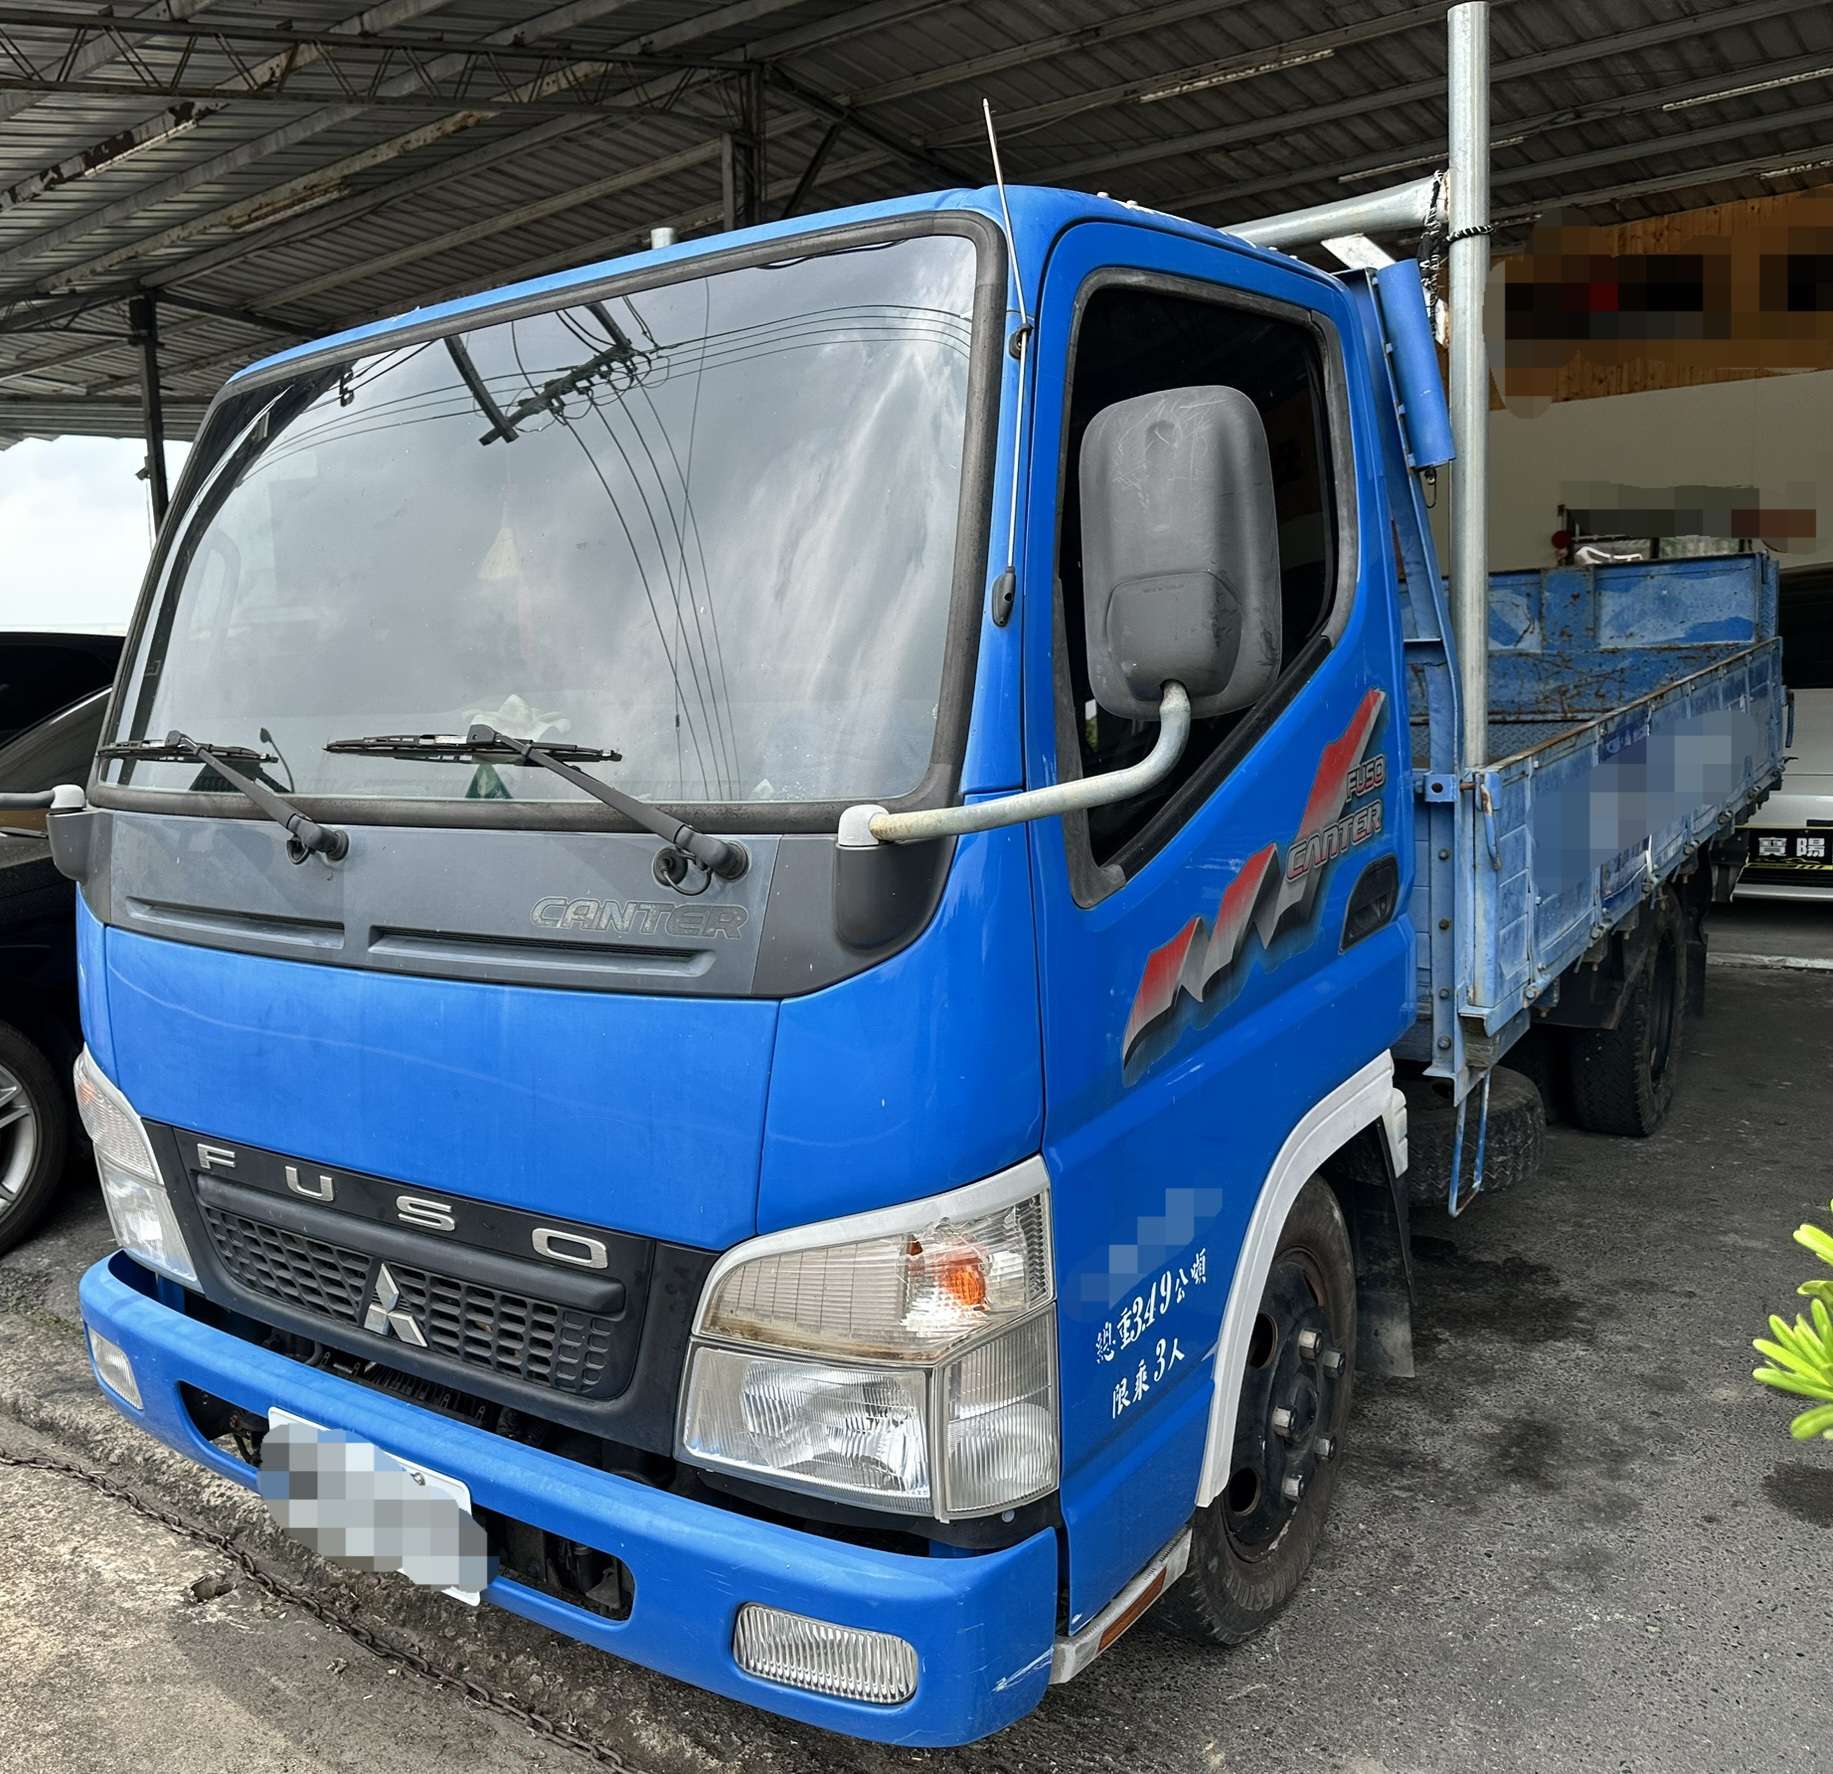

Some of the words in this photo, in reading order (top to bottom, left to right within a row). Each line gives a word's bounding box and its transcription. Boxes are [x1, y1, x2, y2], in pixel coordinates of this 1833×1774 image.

[1345, 753, 1385, 803] FUSO
[1286, 798, 1382, 883] CANTER
[529, 895, 750, 941] CANTER
[197, 1142, 609, 1270] FUSO
